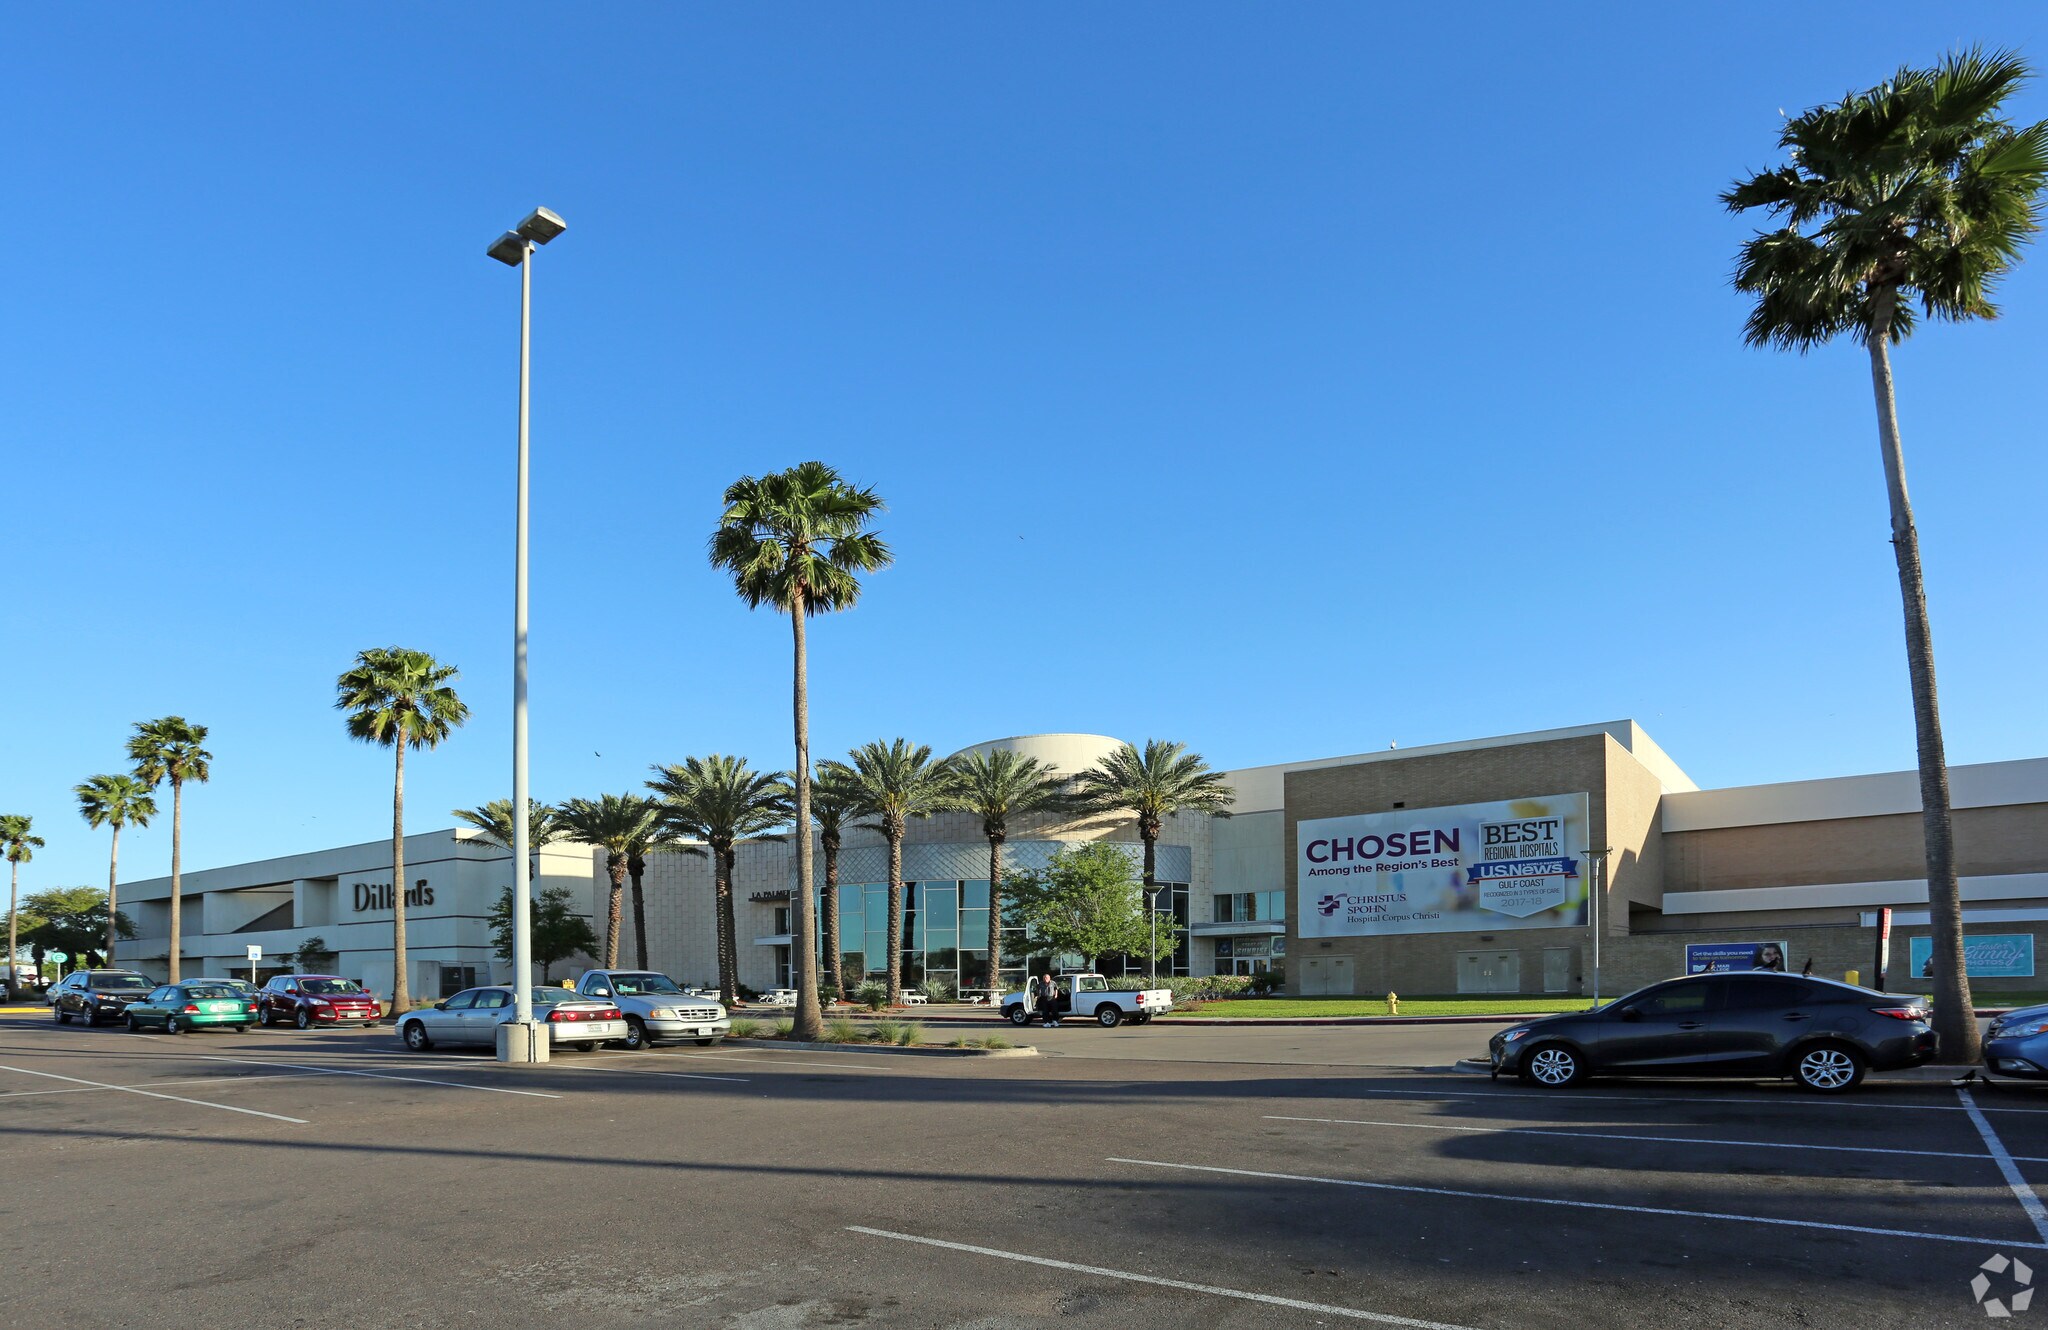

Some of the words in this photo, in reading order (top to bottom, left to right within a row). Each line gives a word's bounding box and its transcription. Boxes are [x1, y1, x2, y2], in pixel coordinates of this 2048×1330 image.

[1484, 820, 1558, 845] BEST
[1306, 828, 1460, 863] CHOSEN
[1484, 845, 1518, 861] REGIONAL
[1519, 841, 1558, 858] HOSPITALS
[1308, 868, 1350, 876] Among
[1353, 864, 1373, 873] the
[1376, 859, 1428, 873] Region's
[1431, 857, 1459, 868] Best
[1498, 880, 1518, 889] GULF
[1519, 878, 1545, 888] COAST
[352, 879, 434, 912] Dillrd's
[1347, 893, 1407, 905] CHRISTUS
[1483, 890, 1513, 898] RECOGNIZED
[1501, 897, 1542, 907] 2017-18
[1347, 904, 1387, 915] SPOHN
[1347, 914, 1380, 924] Hospital
[1382, 913, 1411, 922] Corpus
[1412, 911, 1440, 920] Christi
[1976, 942, 2009, 950] Easter
[1964, 941, 2026, 966] Bunny
